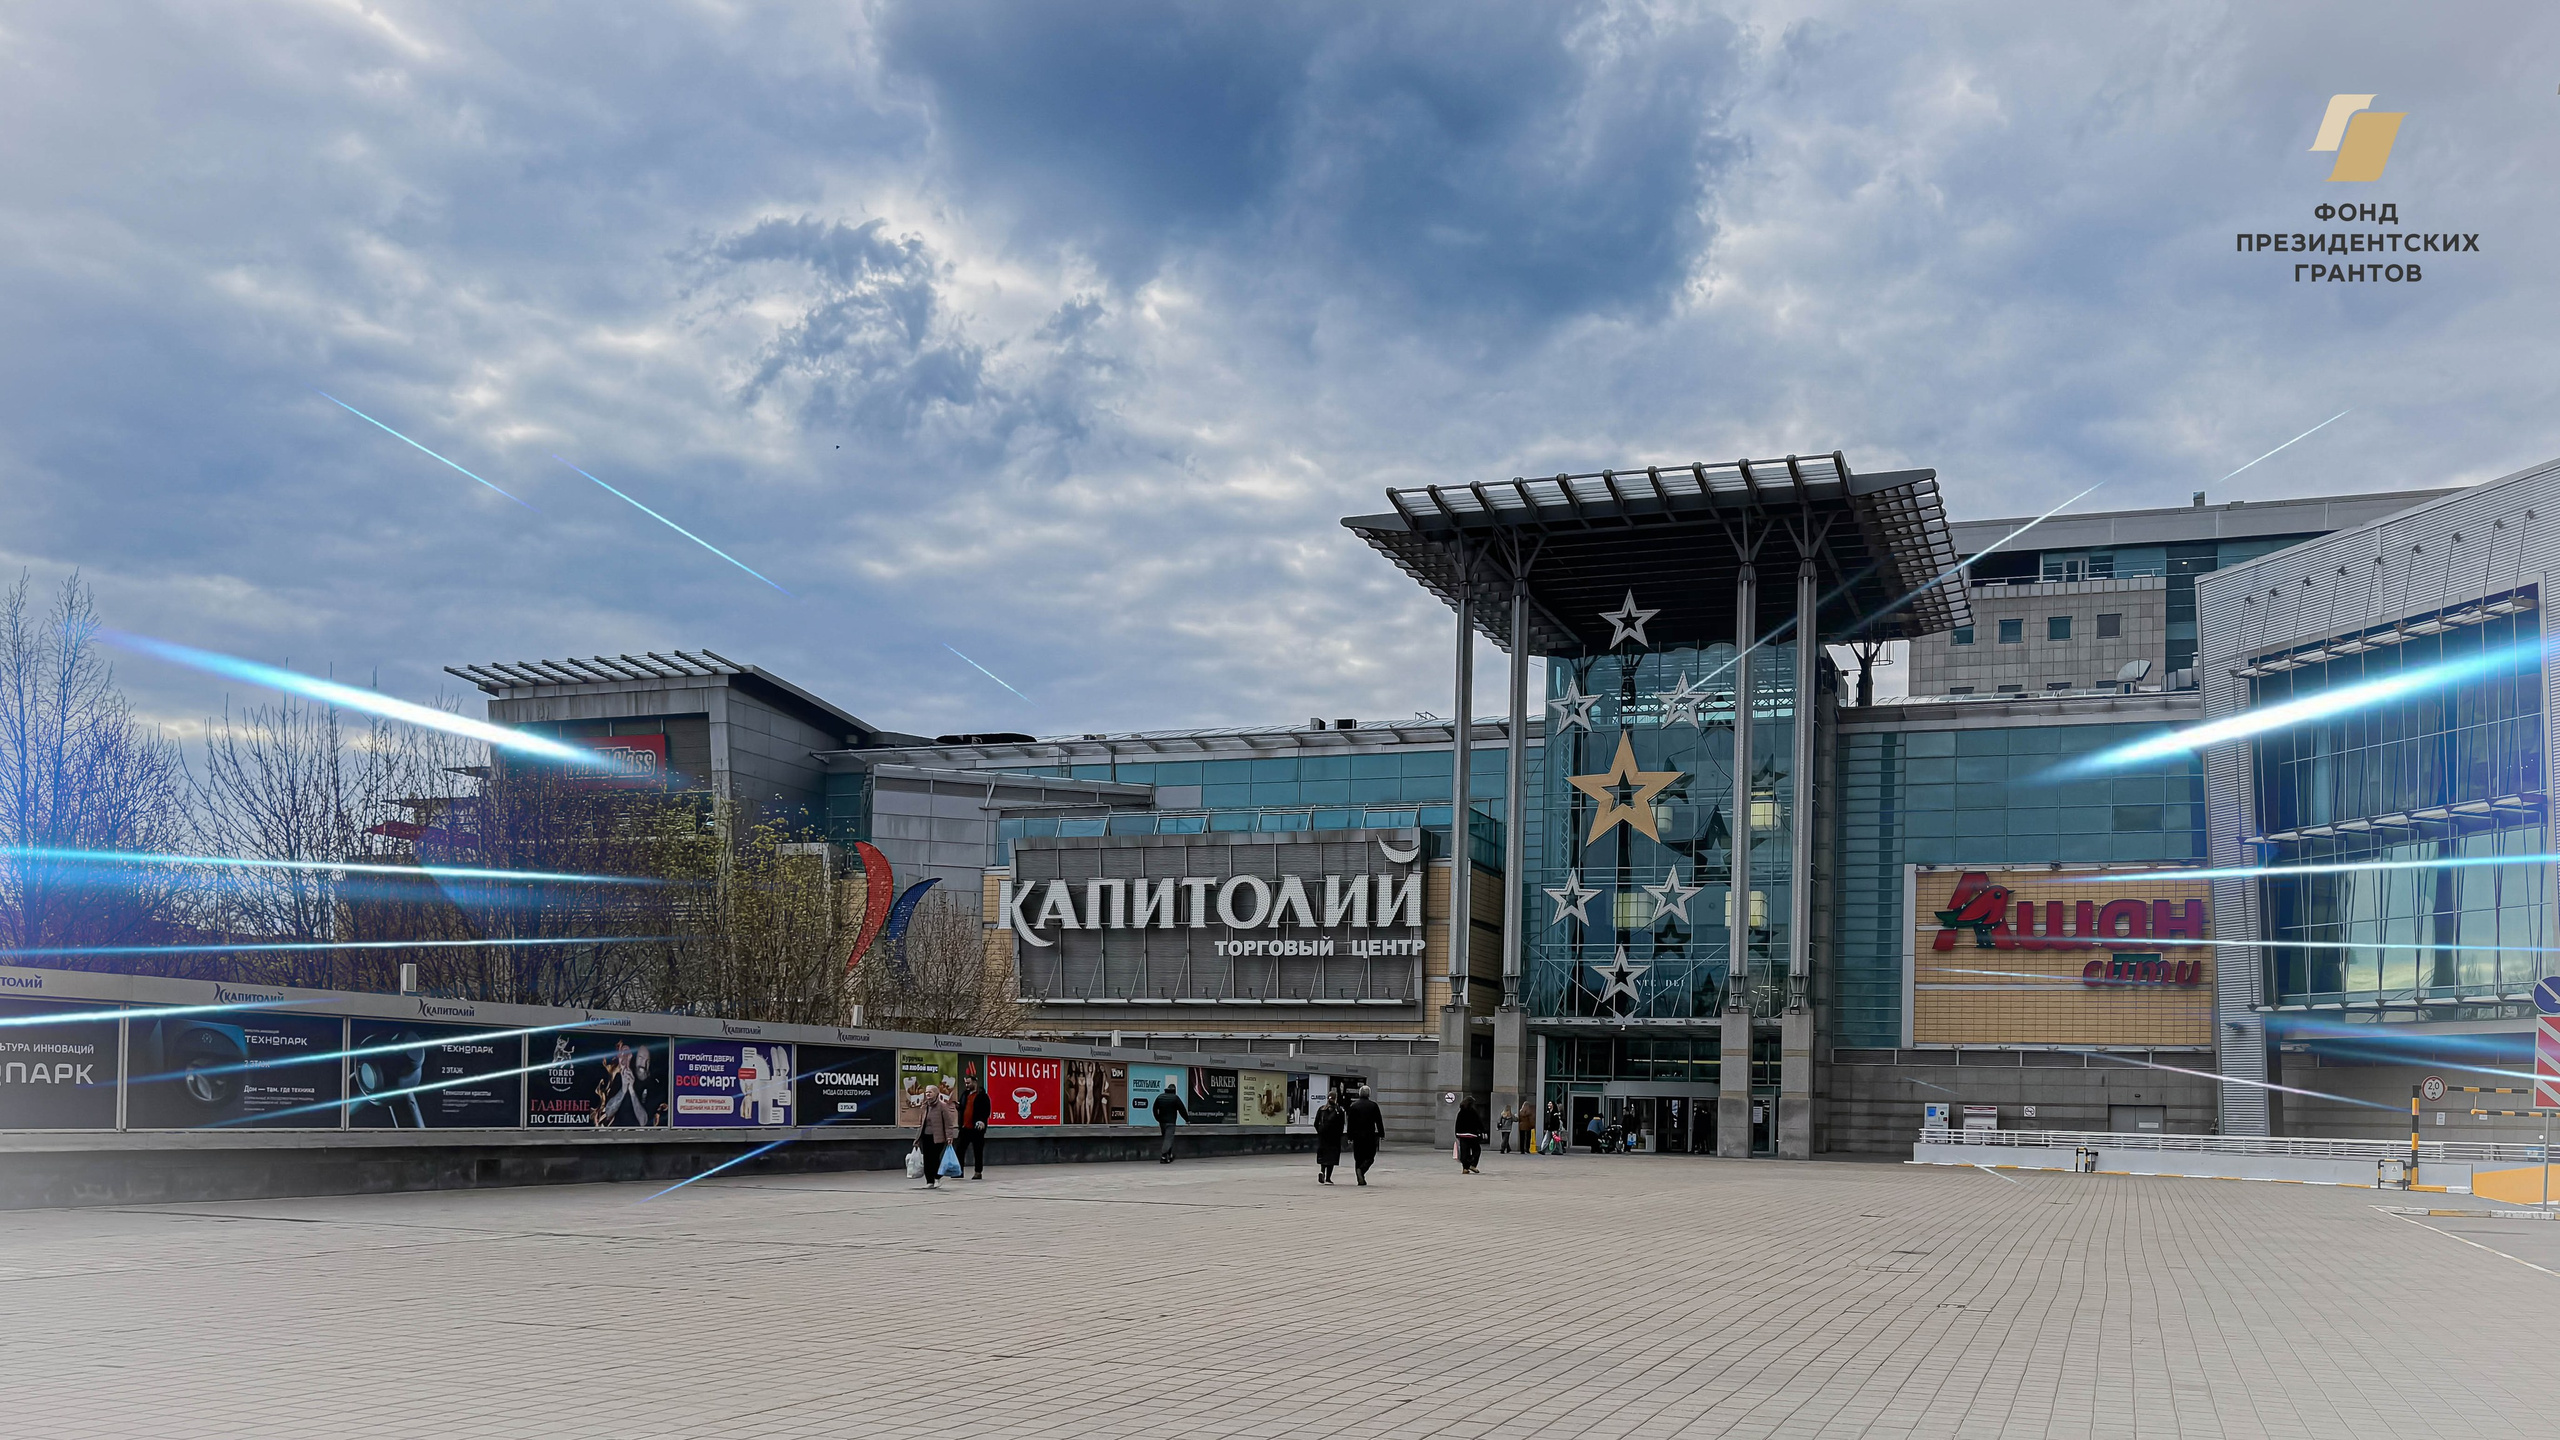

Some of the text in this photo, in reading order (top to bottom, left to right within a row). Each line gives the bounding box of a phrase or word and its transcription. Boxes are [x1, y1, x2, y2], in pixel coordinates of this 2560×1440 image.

[996, 834, 1424, 947] КАПИТОЛИЙ
[1214, 936, 1427, 959] ТОРГОВЫЙ ЦЕНТР
[422, 1002, 475, 1017] КАПИТОЛИЙ
[244, 1035, 308, 1046] ТЕХНОПАРК
[33, 1043, 95, 1054] ИННОВАЦИЙ
[441, 1044, 494, 1054] ТЕХНОПАРК
[678, 1052, 713, 1062] ОТКРОЙТЕ
[713, 1055, 735, 1063] ДВЕРИ
[0, 1062, 94, 1085] ПАРК
[446, 1066, 464, 1074] ЭТАЖ
[548, 1069, 575, 1077] TORRO
[989, 1060, 1058, 1079] SUNLIGHT
[549, 1077, 574, 1085] GRILL
[815, 1072, 879, 1086] СТОКМАНН
[1210, 1075, 1236, 1087] BARKER
[2428, 1081, 2440, 1091] 2,0
[530, 1099, 590, 1112] ГЛАВНЫЕ
[530, 1112, 590, 1124] ПО СТЕЙКАМ
